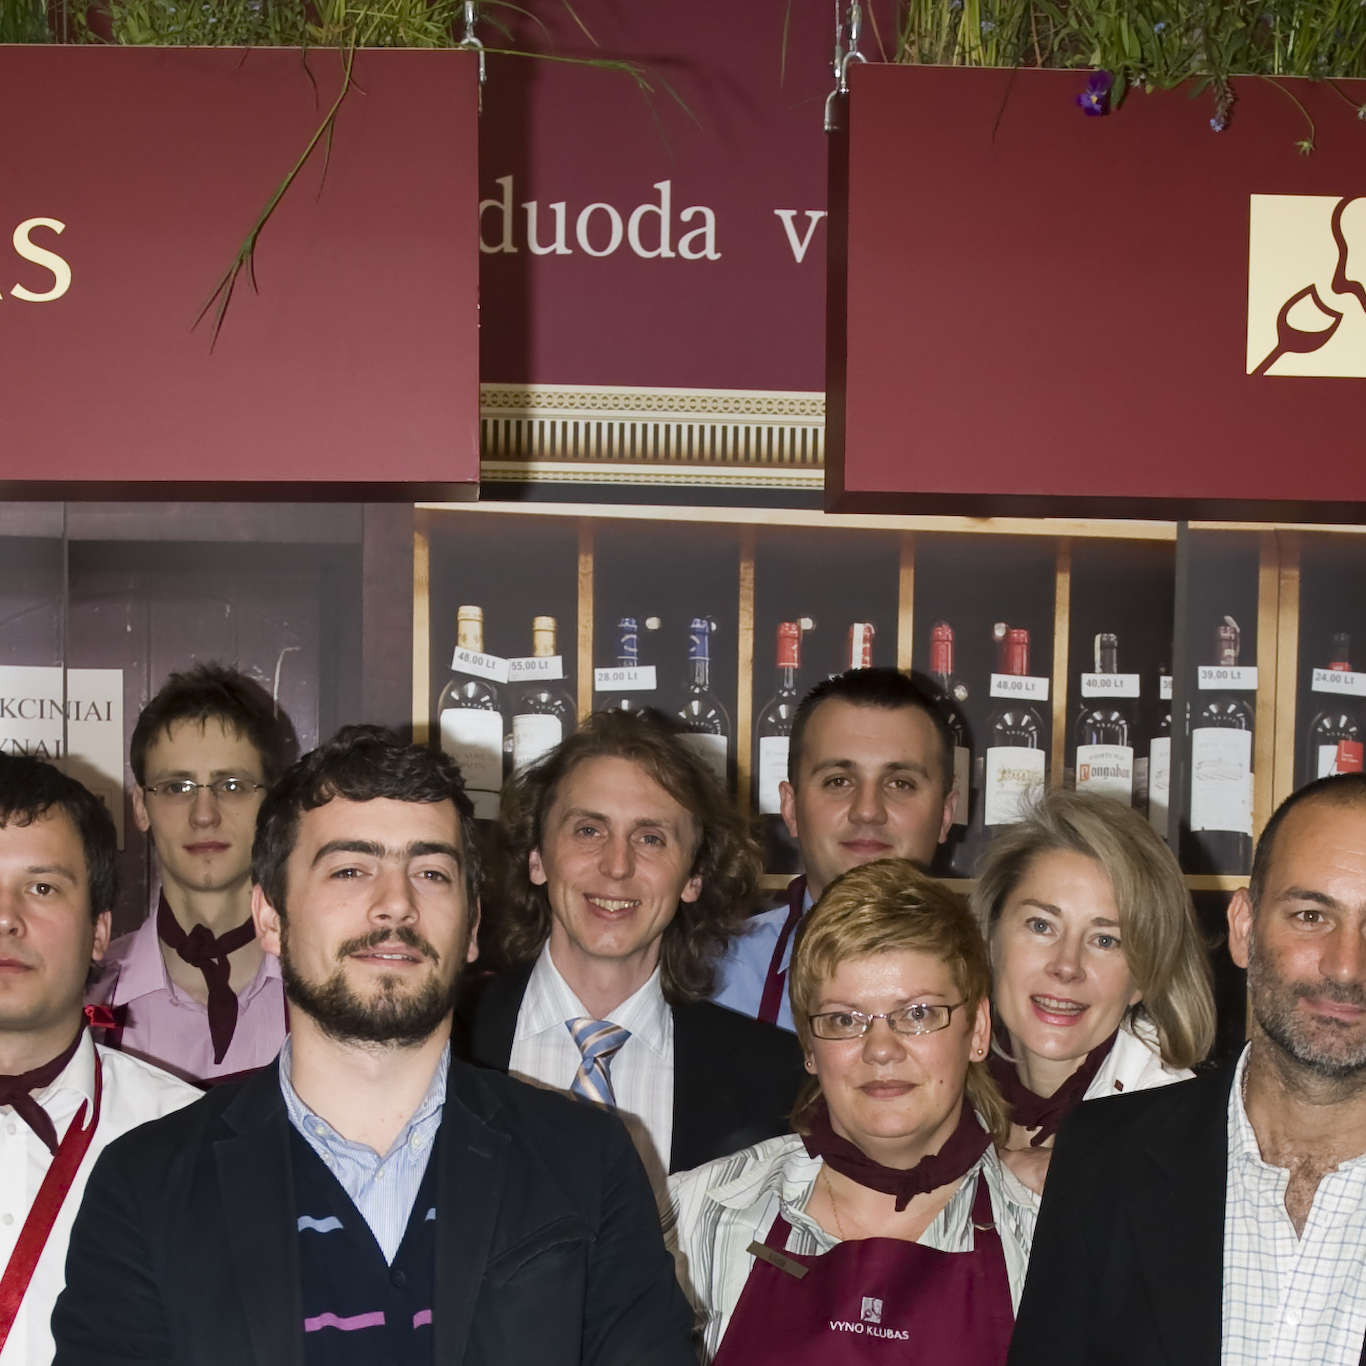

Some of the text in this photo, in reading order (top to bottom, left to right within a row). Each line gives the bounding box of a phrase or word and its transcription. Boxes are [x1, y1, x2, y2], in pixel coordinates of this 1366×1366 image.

[458, 651, 496, 670] 48,00 Lt
[511, 660, 549, 671] 55,00 Lt
[597, 671, 638, 682] 28,00 Lt
[1201, 670, 1241, 681] 39,00 Lt
[1315, 672, 1355, 685] 24,00 Lt
[996, 680, 1036, 691] 48,00 Lt
[1085, 678, 1124, 689] 40,00 Lt
[829, 1320, 909, 1341] VYNO KLUBAS
